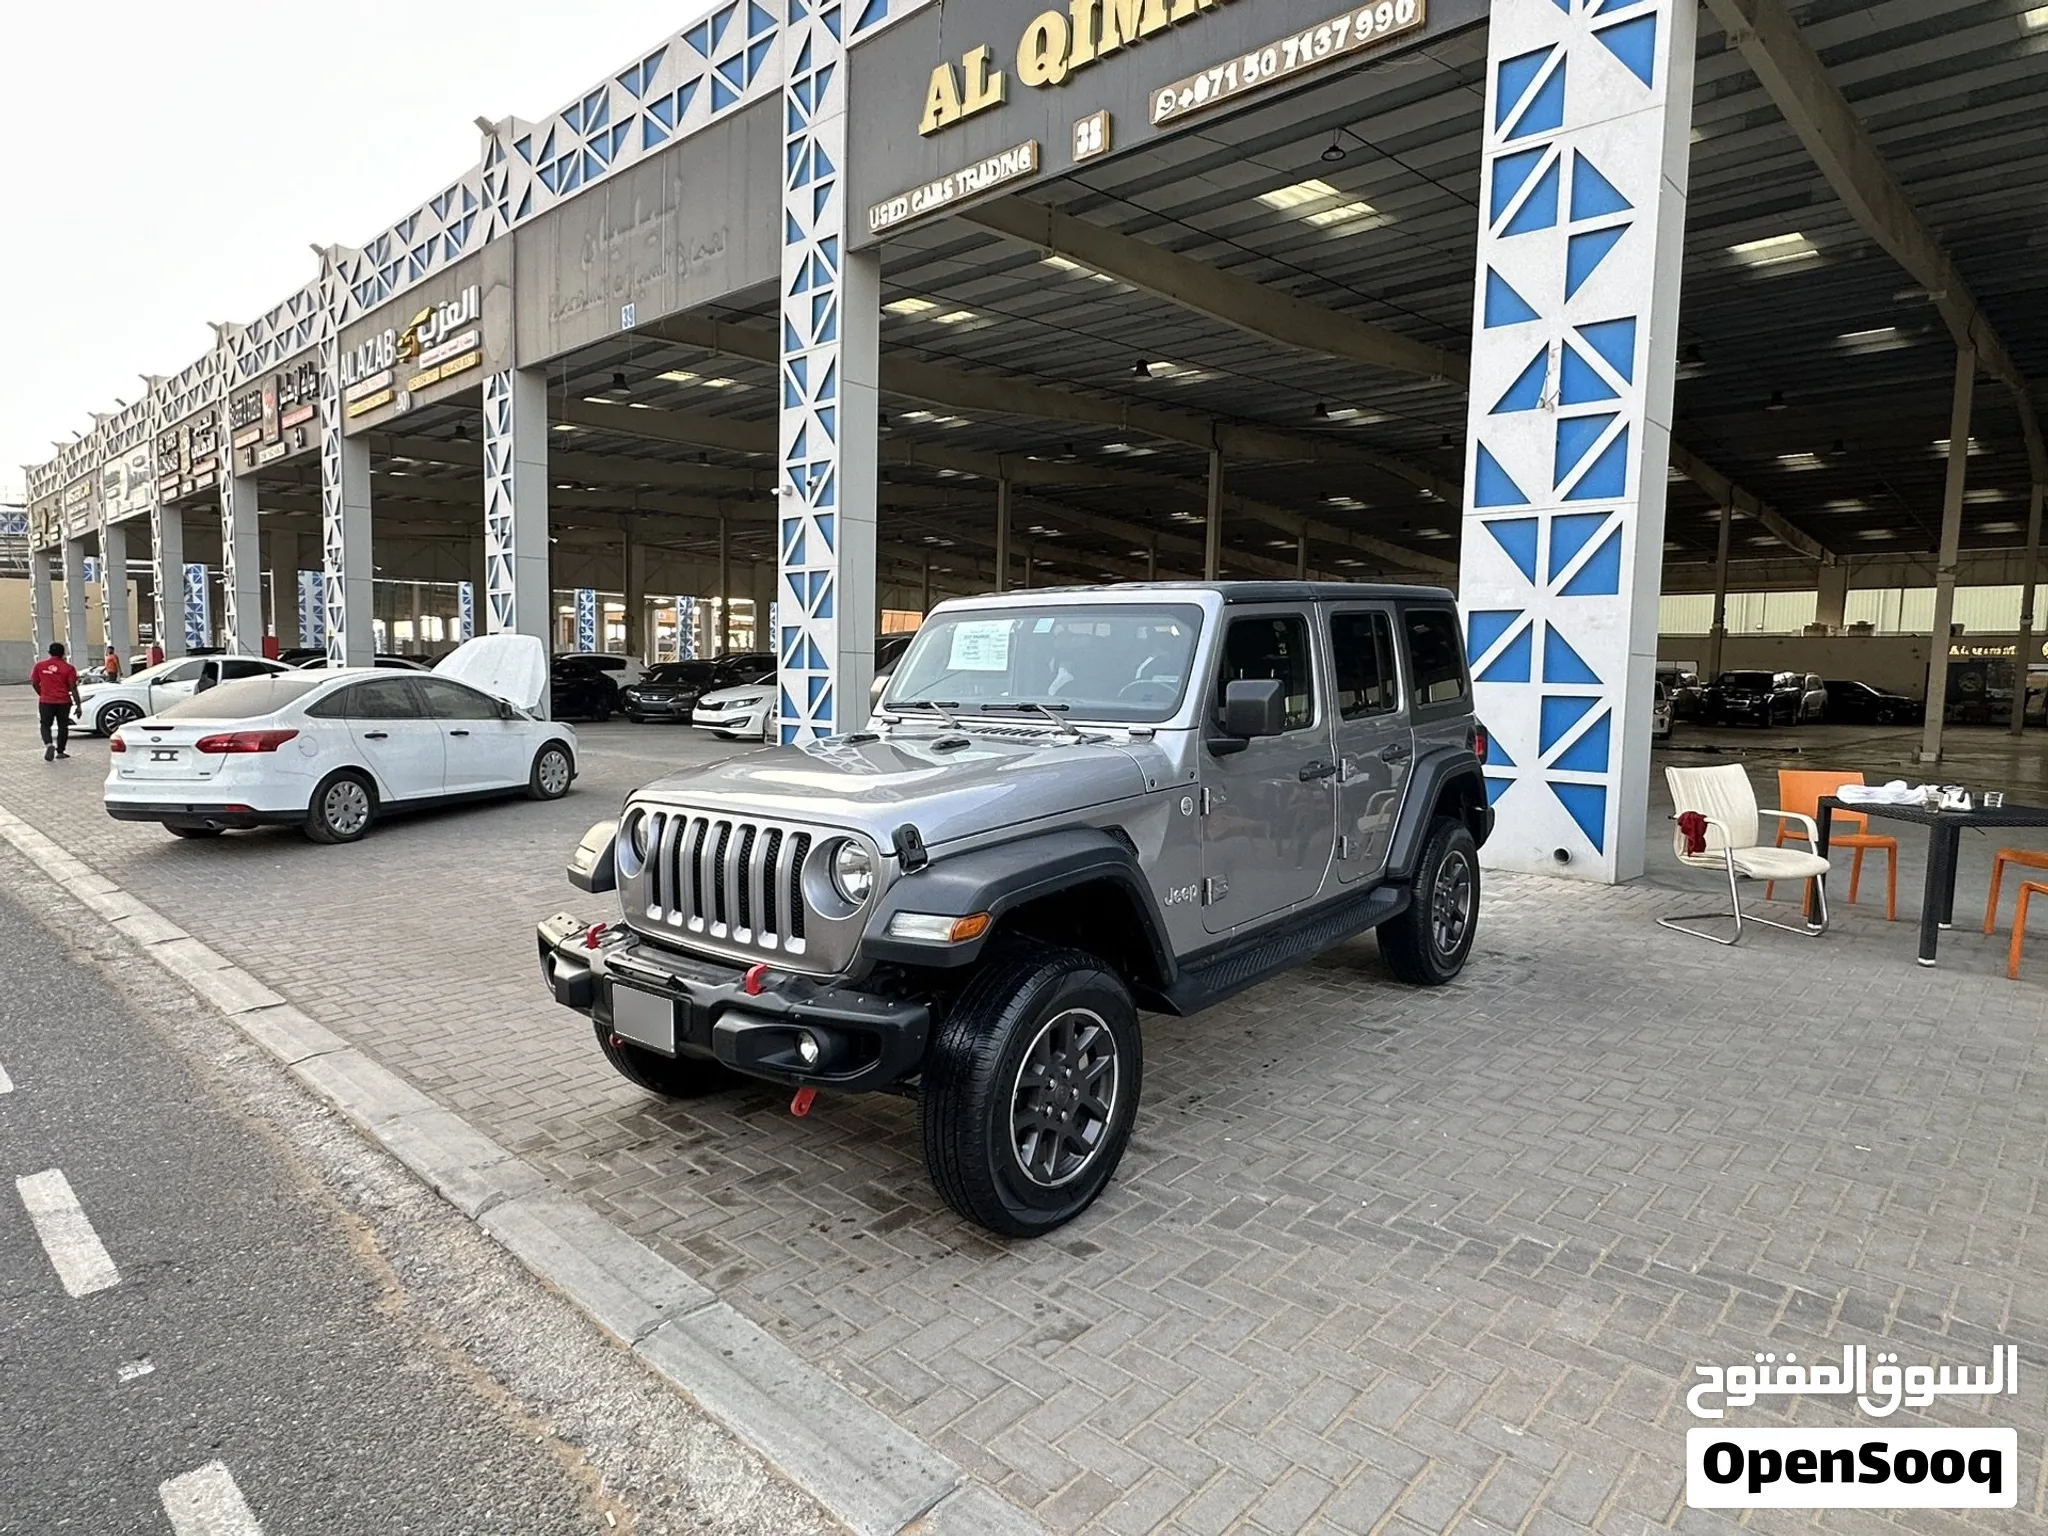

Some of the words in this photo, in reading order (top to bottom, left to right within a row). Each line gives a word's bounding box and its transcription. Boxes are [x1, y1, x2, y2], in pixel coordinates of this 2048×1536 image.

[918, 44, 1004, 137] AL
[1016, 0, 1214, 87] QIM
[1243, 48, 1277, 85] 50
[1354, 0, 1416, 41] 990
[1076, 116, 1102, 154] 38
[869, 198, 908, 229] USED
[911, 178, 954, 214] CARS
[956, 145, 1031, 195] TRADING
[623, 304, 634, 328] 39
[1164, 884, 1197, 906] Jeep
